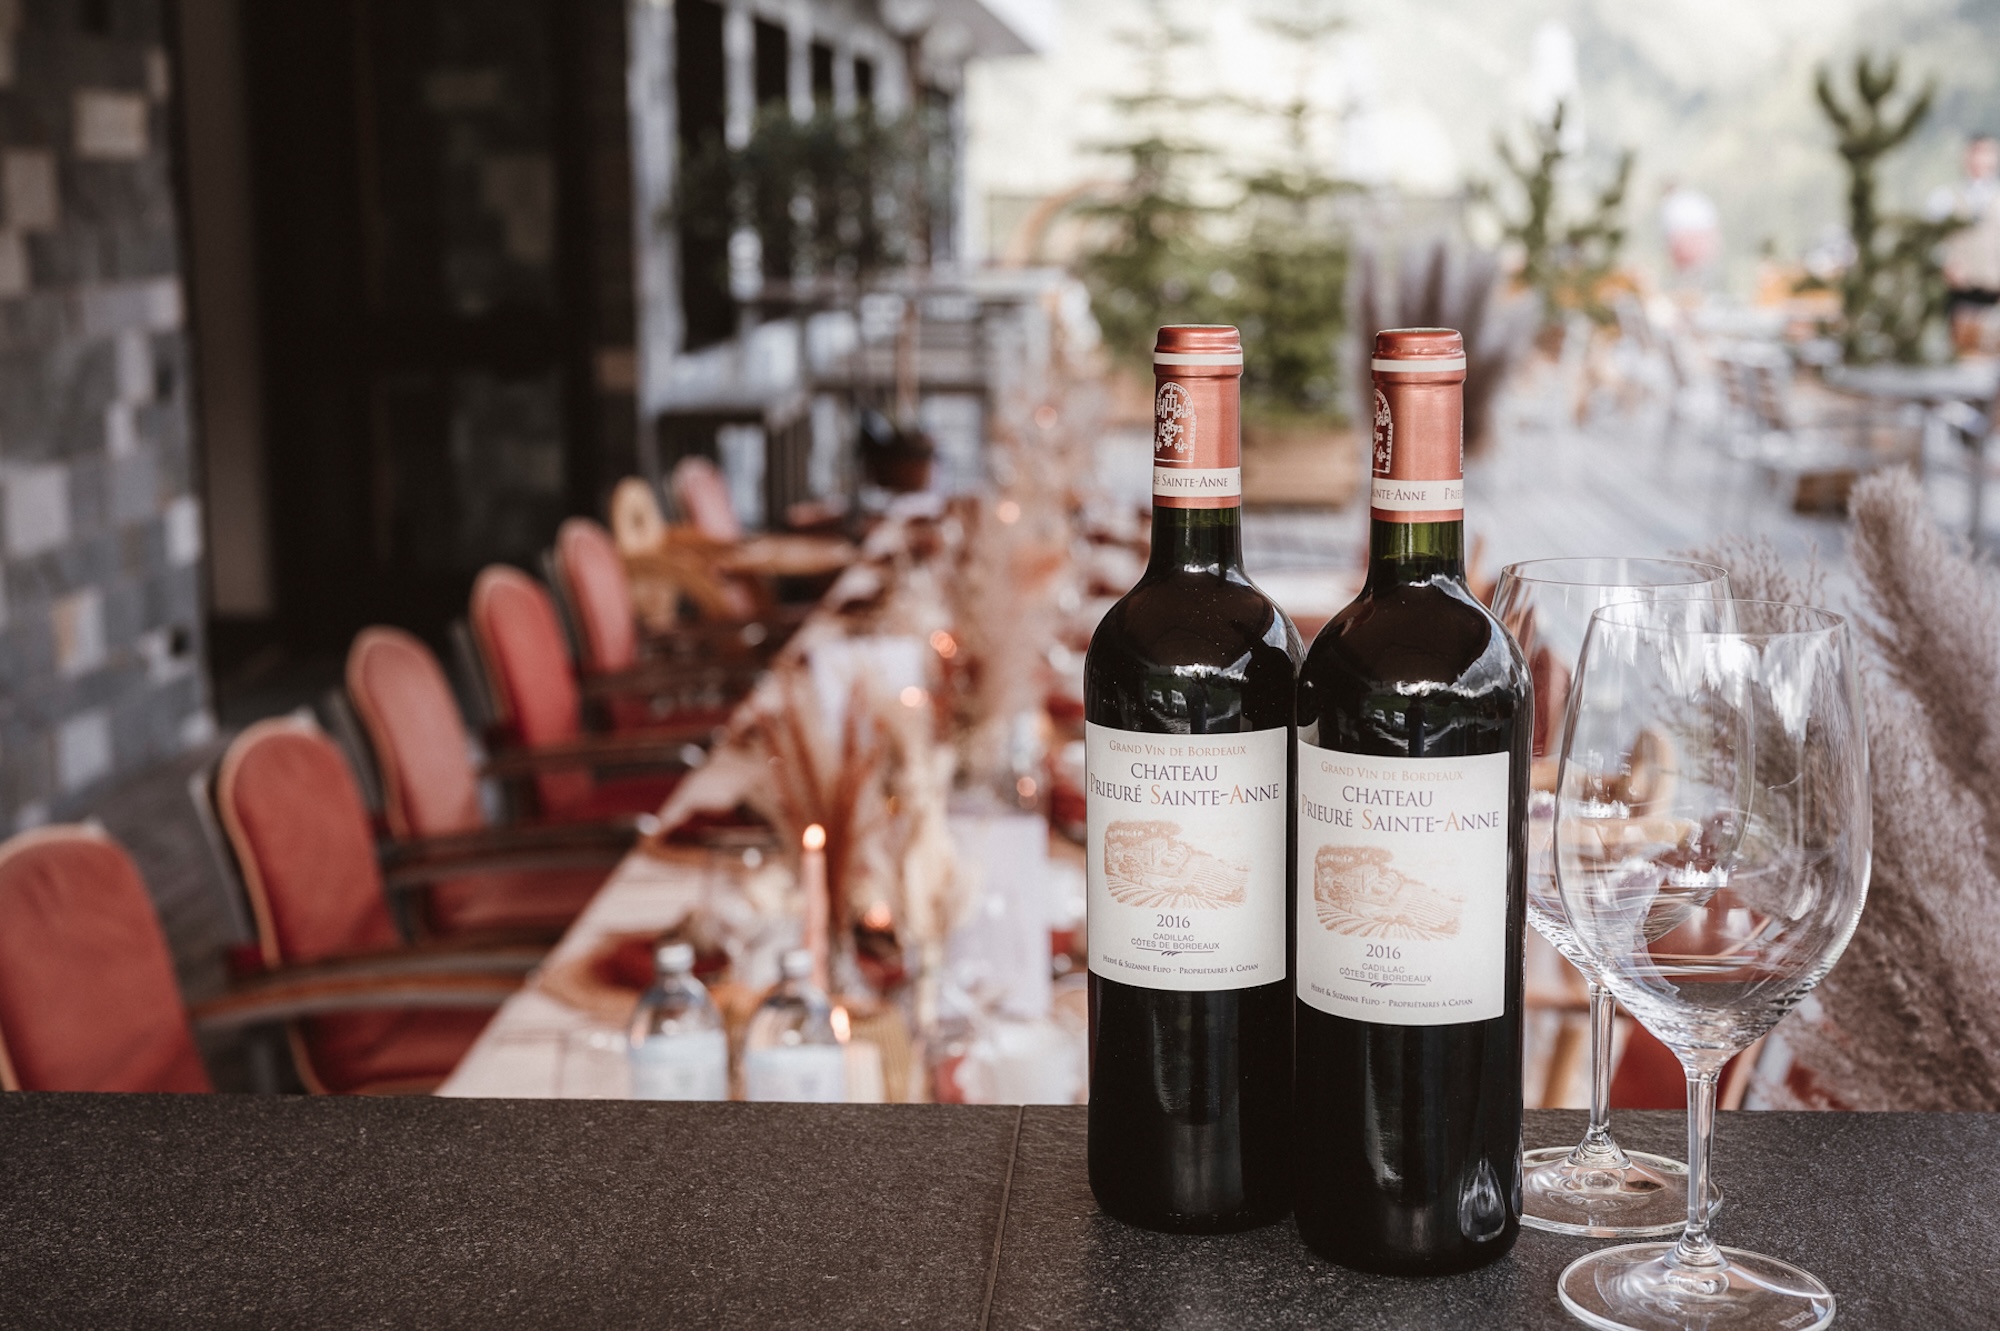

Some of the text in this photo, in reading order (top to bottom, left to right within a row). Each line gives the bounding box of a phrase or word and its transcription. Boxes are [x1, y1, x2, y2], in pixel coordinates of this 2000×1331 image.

[1161, 474, 1228, 488] SAINTE-ANNE
[1109, 740, 1247, 757] GRAND VIN DE BORDEAUX
[1130, 762, 1218, 781] CHATEAU
[1320, 760, 1463, 782] GRAND VIN DE BORDEAUX
[1090, 772, 1280, 806] PRIEURÉ SAINTE-ANNE
[1342, 785, 1433, 807] CHATEAU
[1301, 793, 1499, 833] PRIEURÉ SAINTE-ANNE
[1156, 914, 1191, 929] 2016
[1130, 938, 1220, 950] CÔTES DE BORDEAUX
[1152, 932, 1195, 941] CADILLAC
[1366, 943, 1401, 960] 2016
[1124, 960, 1151, 971] SUZANNE
[1361, 963, 1405, 973] CADILLAC
[1339, 967, 1432, 982] CÔTES DE BORDEAUX
[1332, 990, 1359, 1003] SUZANNE
